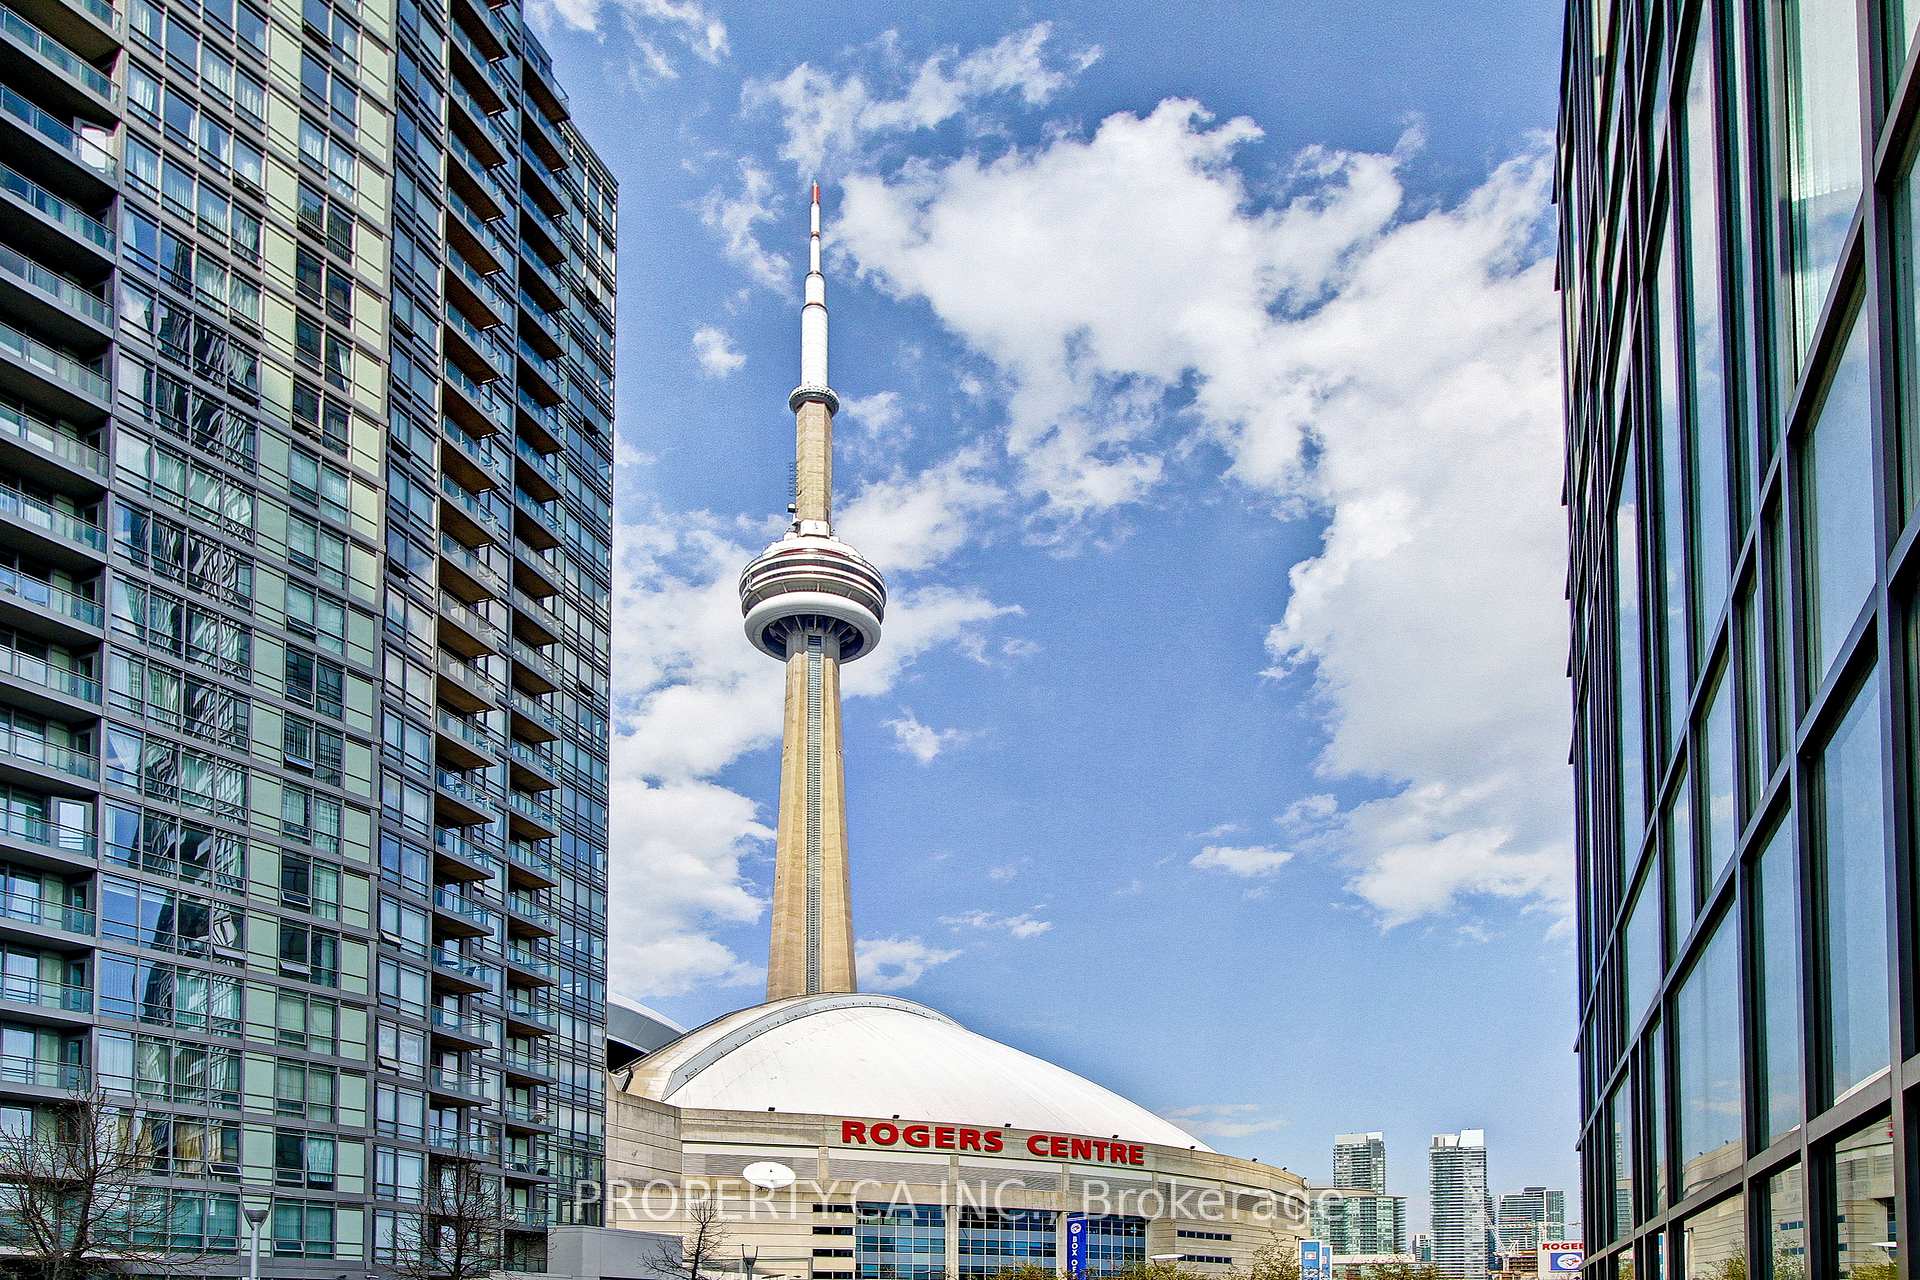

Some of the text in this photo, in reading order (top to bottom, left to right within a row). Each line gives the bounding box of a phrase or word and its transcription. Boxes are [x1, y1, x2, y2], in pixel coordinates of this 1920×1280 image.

[841, 1120, 1145, 1165] ROGERS CENTRE
[1071, 1235, 1079, 1257] BOX
